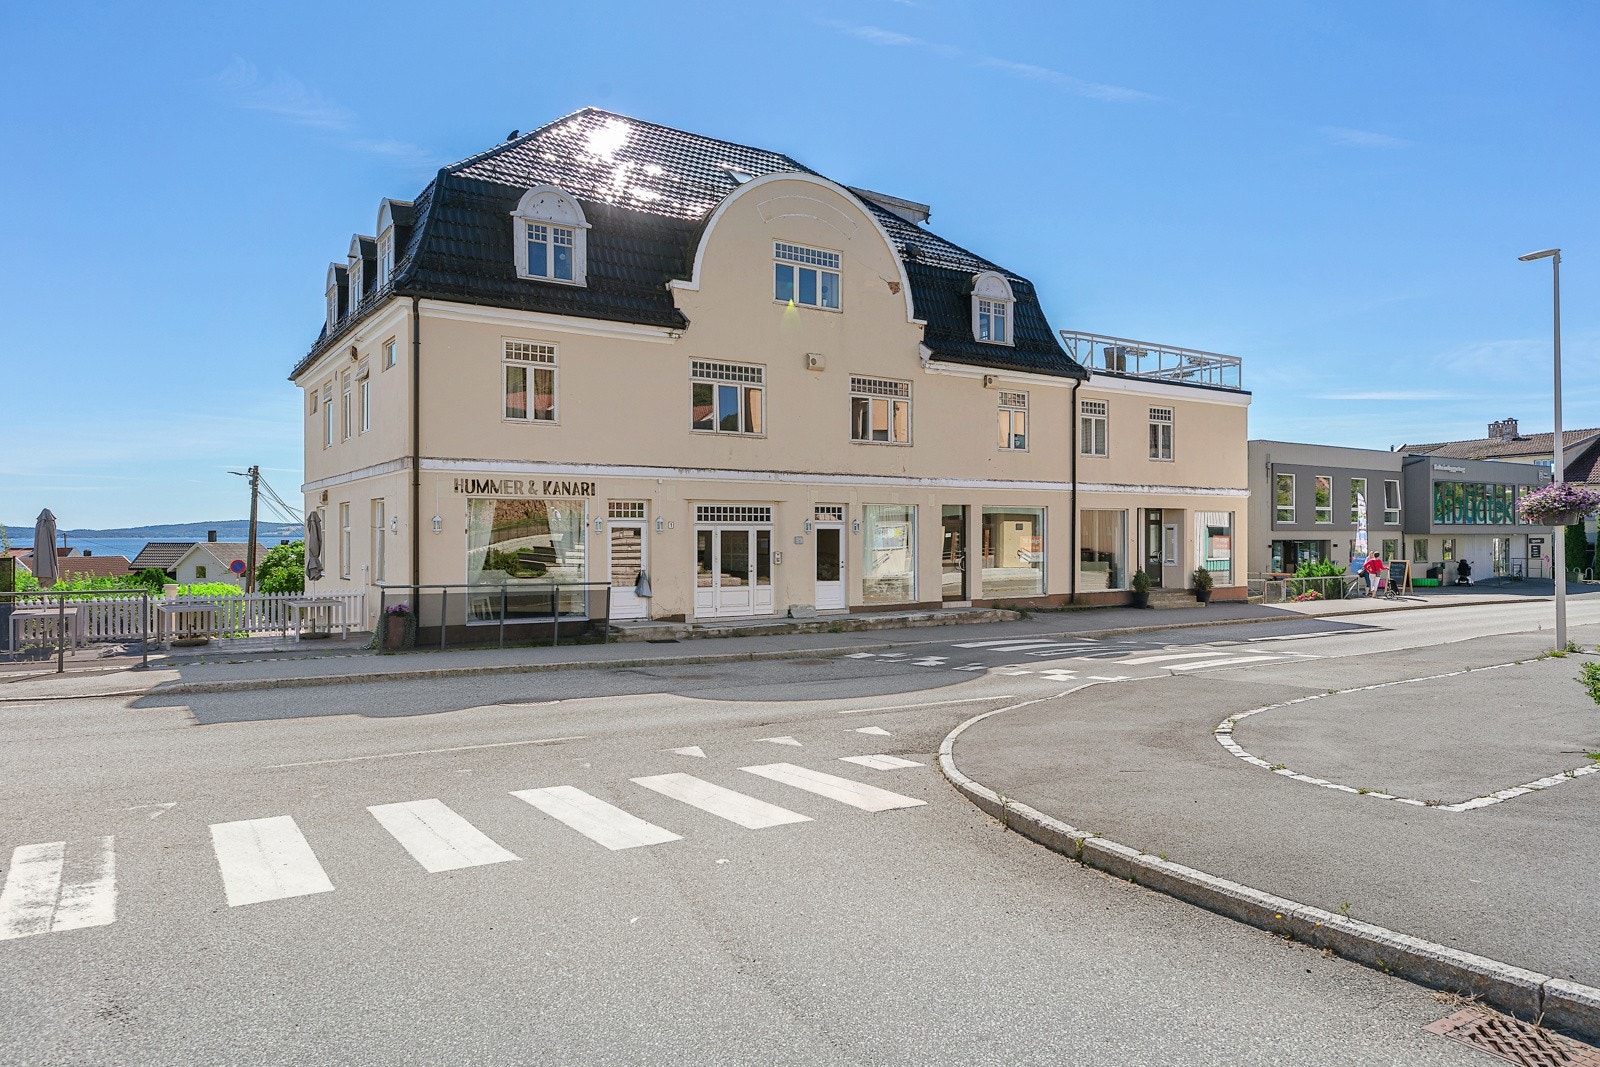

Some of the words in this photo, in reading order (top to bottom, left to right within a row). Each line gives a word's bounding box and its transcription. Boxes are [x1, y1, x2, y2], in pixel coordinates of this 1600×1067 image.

[453, 478, 524, 494] HUMMER
[528, 480, 538, 495] &
[542, 480, 595, 496] KANARI
